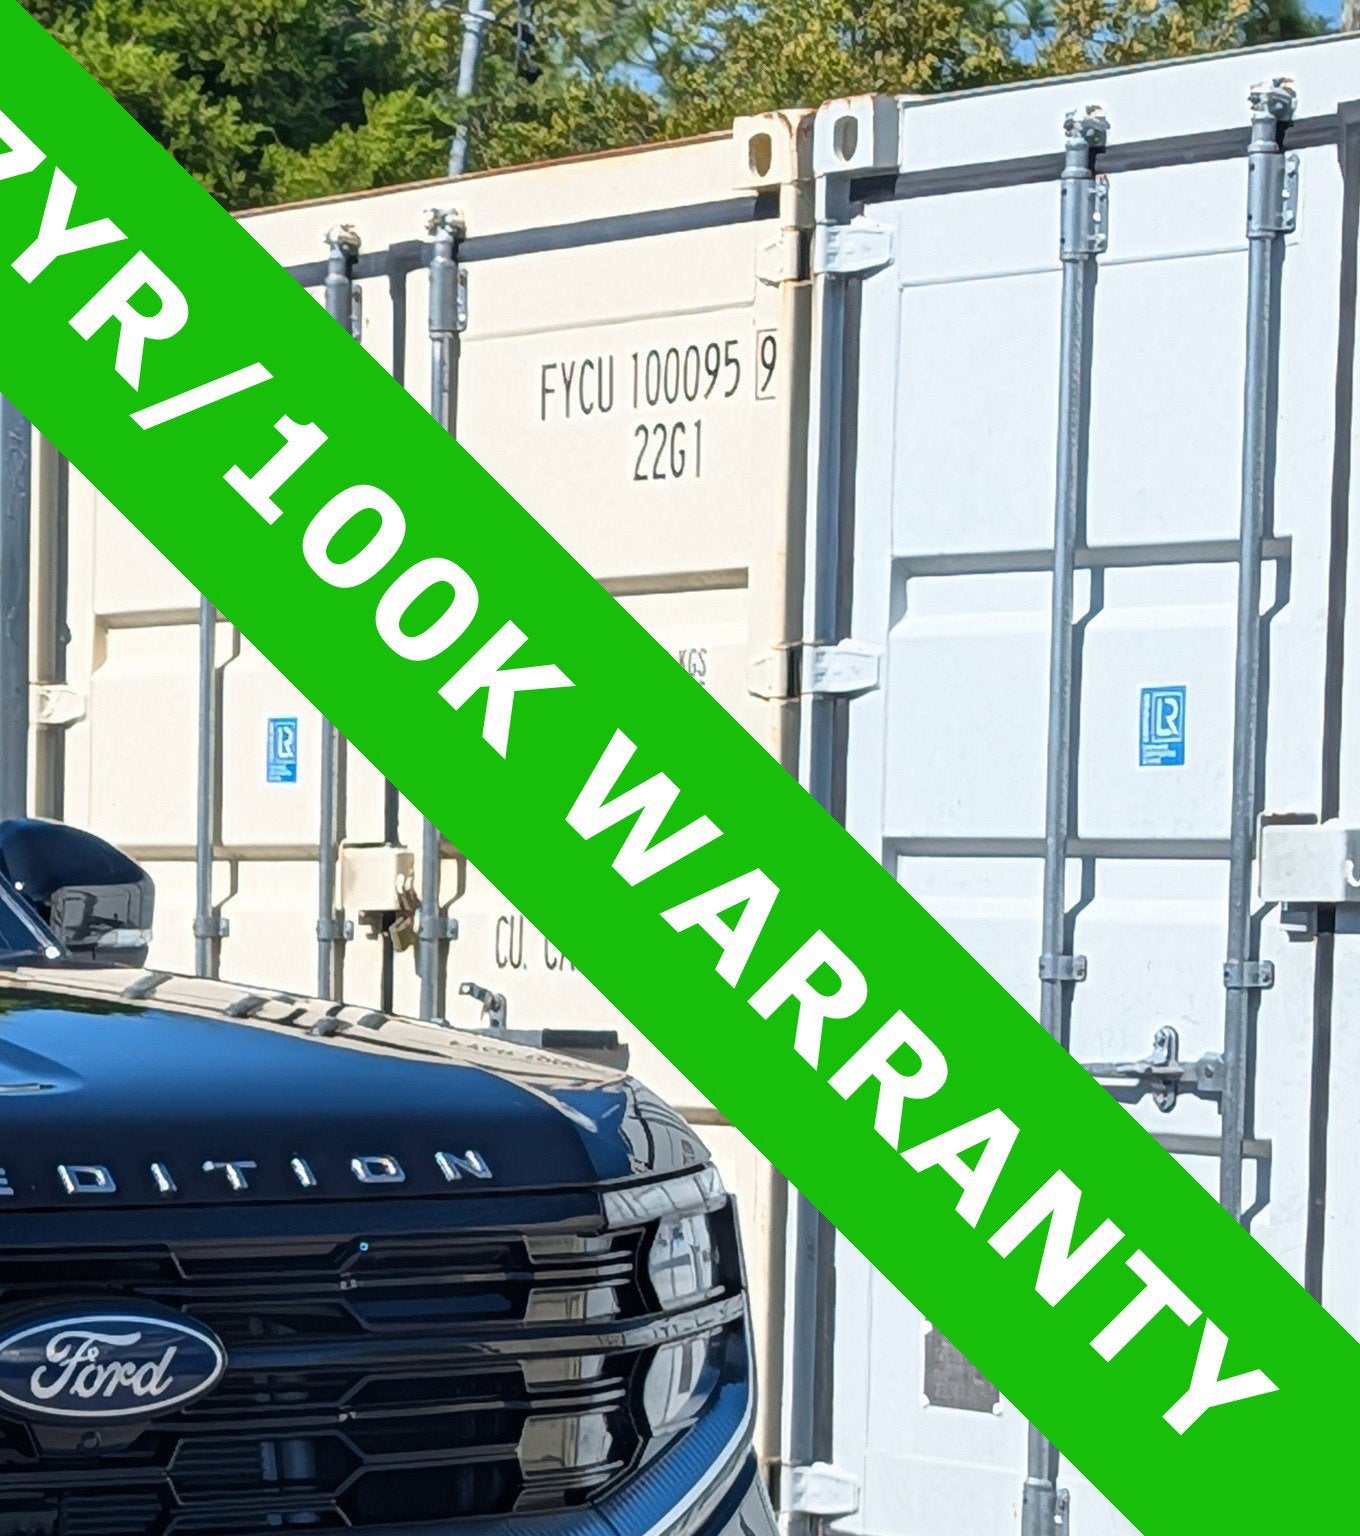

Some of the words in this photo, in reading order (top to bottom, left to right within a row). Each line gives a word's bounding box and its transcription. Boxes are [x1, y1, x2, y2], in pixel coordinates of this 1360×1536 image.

[541, 354, 614, 421] FYCU
[632, 339, 741, 409] 100095
[760, 335, 777, 392] 9
[633, 418, 702, 481] 22G1
[31, 1331, 178, 1399] Ford
